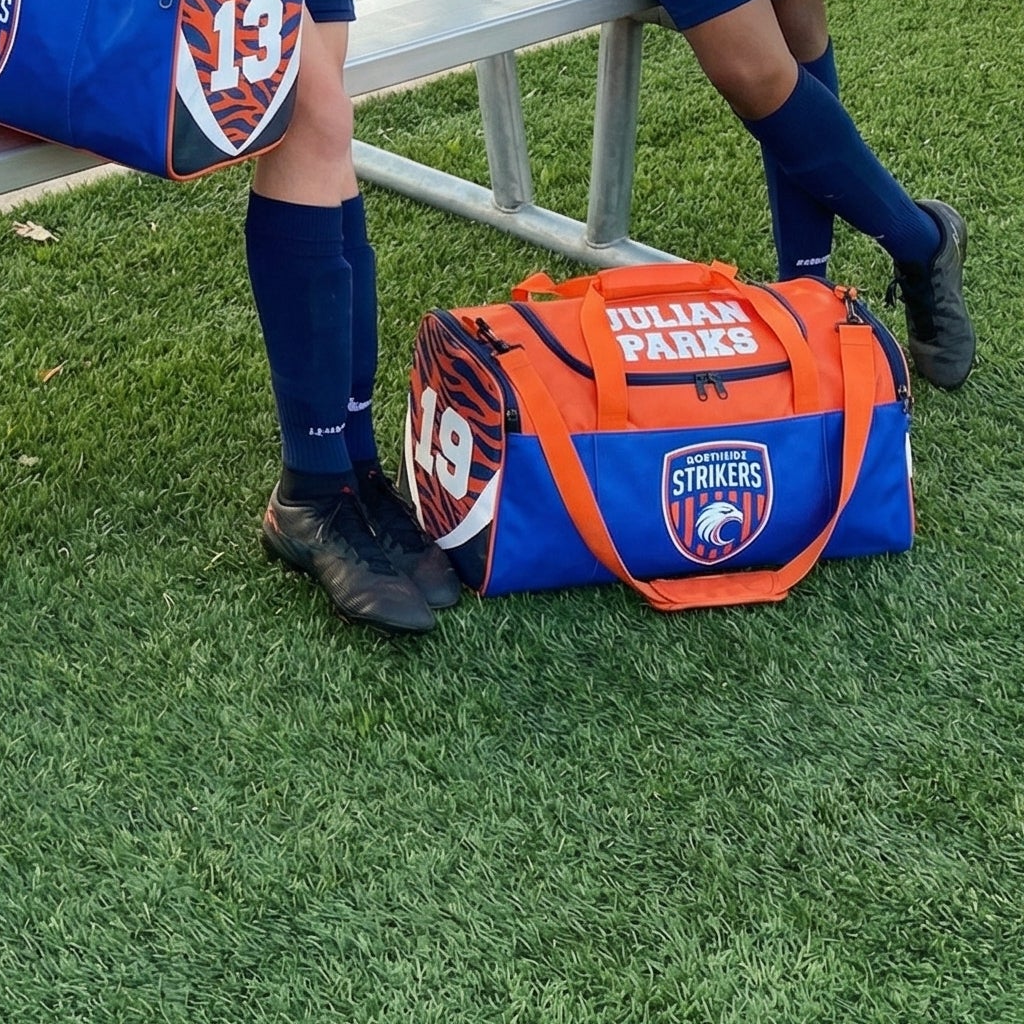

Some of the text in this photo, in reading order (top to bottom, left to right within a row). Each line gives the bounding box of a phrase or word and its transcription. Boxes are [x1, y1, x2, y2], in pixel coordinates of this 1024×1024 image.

[605, 300, 751, 332] JULIAN
[616, 326, 759, 362] PARKS
[415, 386, 474, 501] 19
[672, 461, 762, 496] STRIKERS
